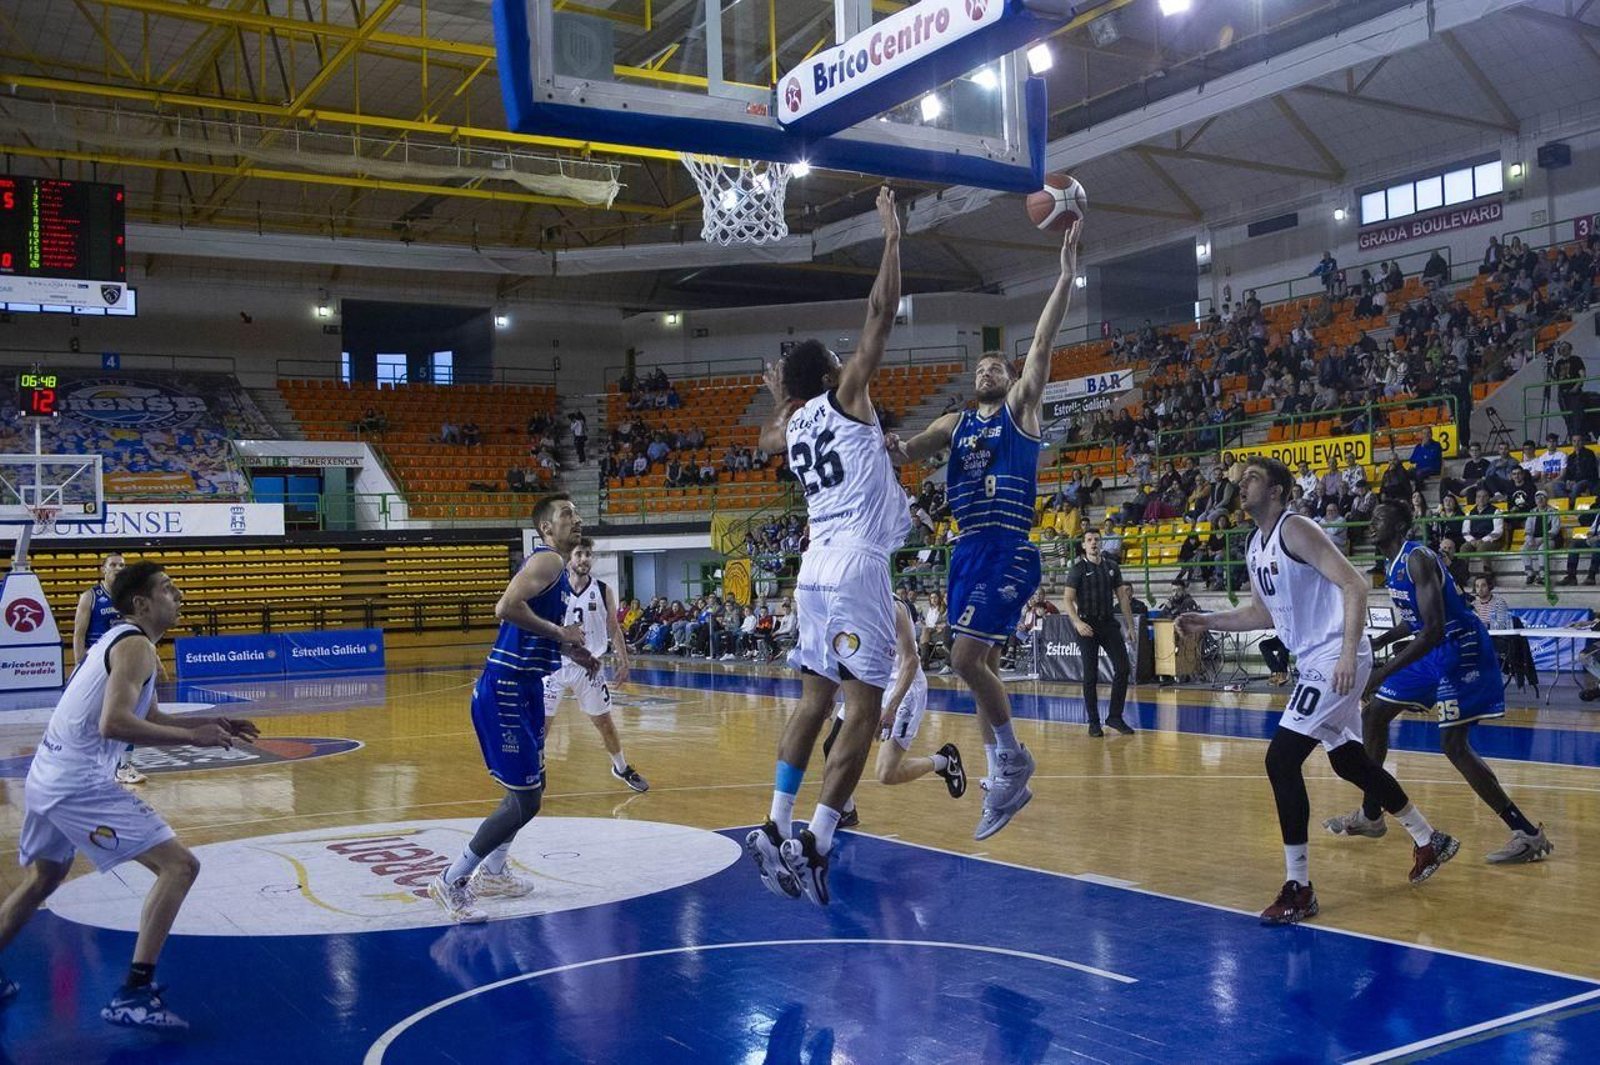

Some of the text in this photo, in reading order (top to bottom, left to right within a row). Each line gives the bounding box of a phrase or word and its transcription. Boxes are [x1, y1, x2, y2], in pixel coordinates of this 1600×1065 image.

[813, 7, 950, 95] BricoCentro
[1359, 205, 1501, 249] GRADA BOULEVARD
[1579, 219, 1590, 236] 3
[107, 356, 116, 368] 4
[21, 375, 57, 388] 06:48
[1086, 373, 1121, 393] BAR
[32, 389, 56, 412] 12
[1438, 431, 1451, 452] 3
[791, 429, 844, 497] 26
[1273, 439, 1367, 467] BOULEVARD
[984, 475, 996, 498] 8
[1257, 566, 1276, 597] 10
[956, 605, 976, 627] 8
[185, 650, 265, 663] Estrella Galicia
[291, 644, 367, 657] Estrella Galicia
[1, 661, 55, 669] BricoCentro
[1289, 684, 1321, 716] 10
